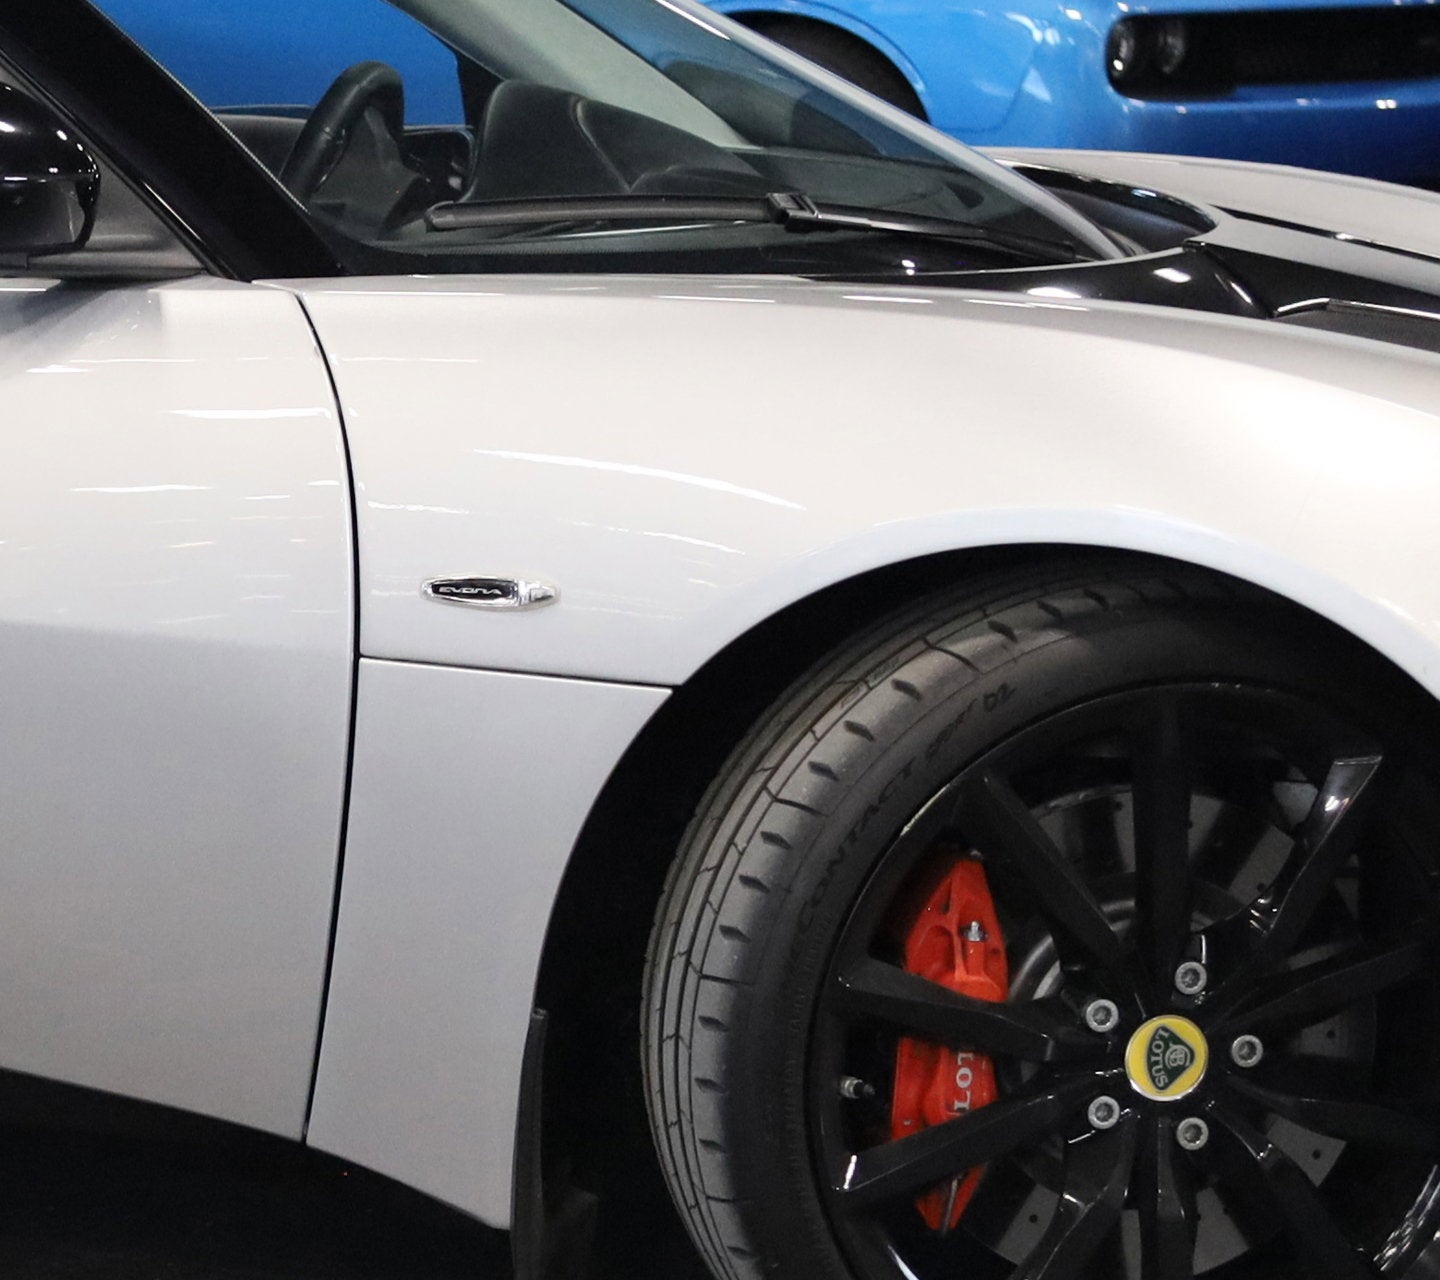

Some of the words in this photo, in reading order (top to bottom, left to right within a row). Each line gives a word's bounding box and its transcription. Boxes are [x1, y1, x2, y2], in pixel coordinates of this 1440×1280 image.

[439, 586, 502, 595] EVORA
[953, 1051, 974, 1111] LOT
[1150, 1027, 1169, 1088] LOTUS
